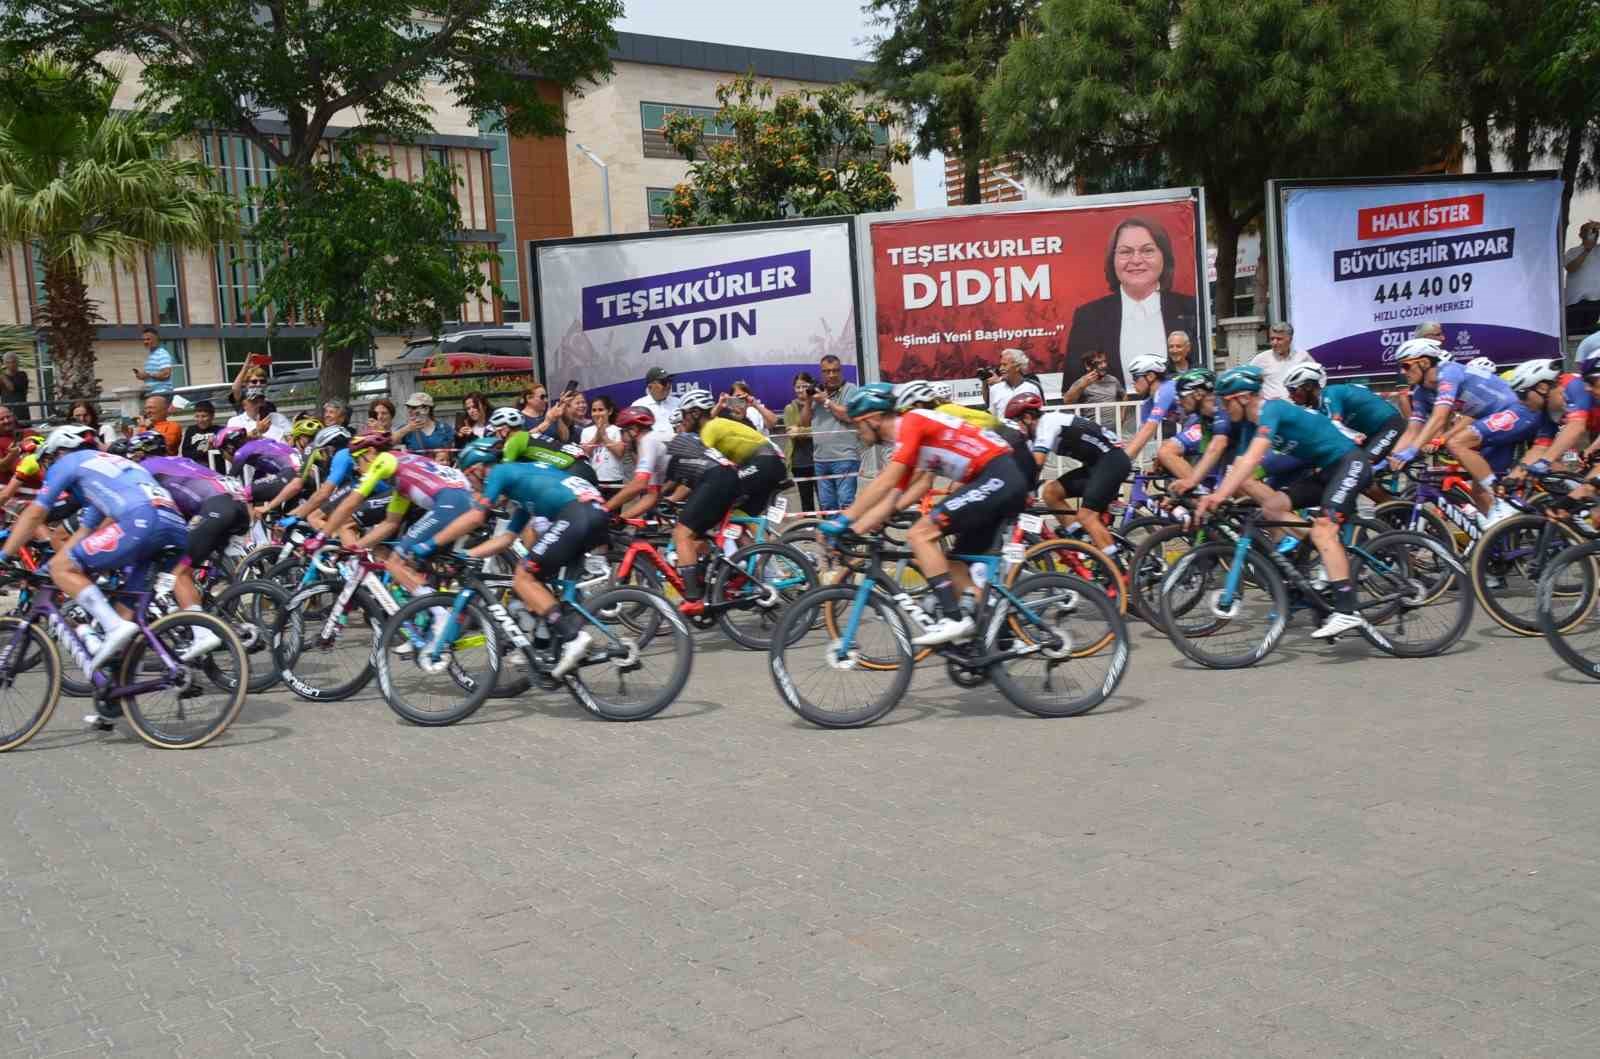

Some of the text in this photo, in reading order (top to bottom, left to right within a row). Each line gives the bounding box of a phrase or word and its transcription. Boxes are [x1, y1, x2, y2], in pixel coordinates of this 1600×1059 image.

[1372, 204, 1471, 232] HALK İSTER
[1339, 236, 1508, 276] BÜYÜKŞEHİR YAPAR
[596, 265, 797, 319] TEŞEKKÜRLER
[903, 264, 1052, 310] DİDİM
[1374, 272, 1473, 304] 444 40 09
[1373, 296, 1474, 322] HIZLI ÇÖZÜM MERKEZİ
[642, 308, 757, 353] AYDIN
[943, 330, 972, 343] Yeni
